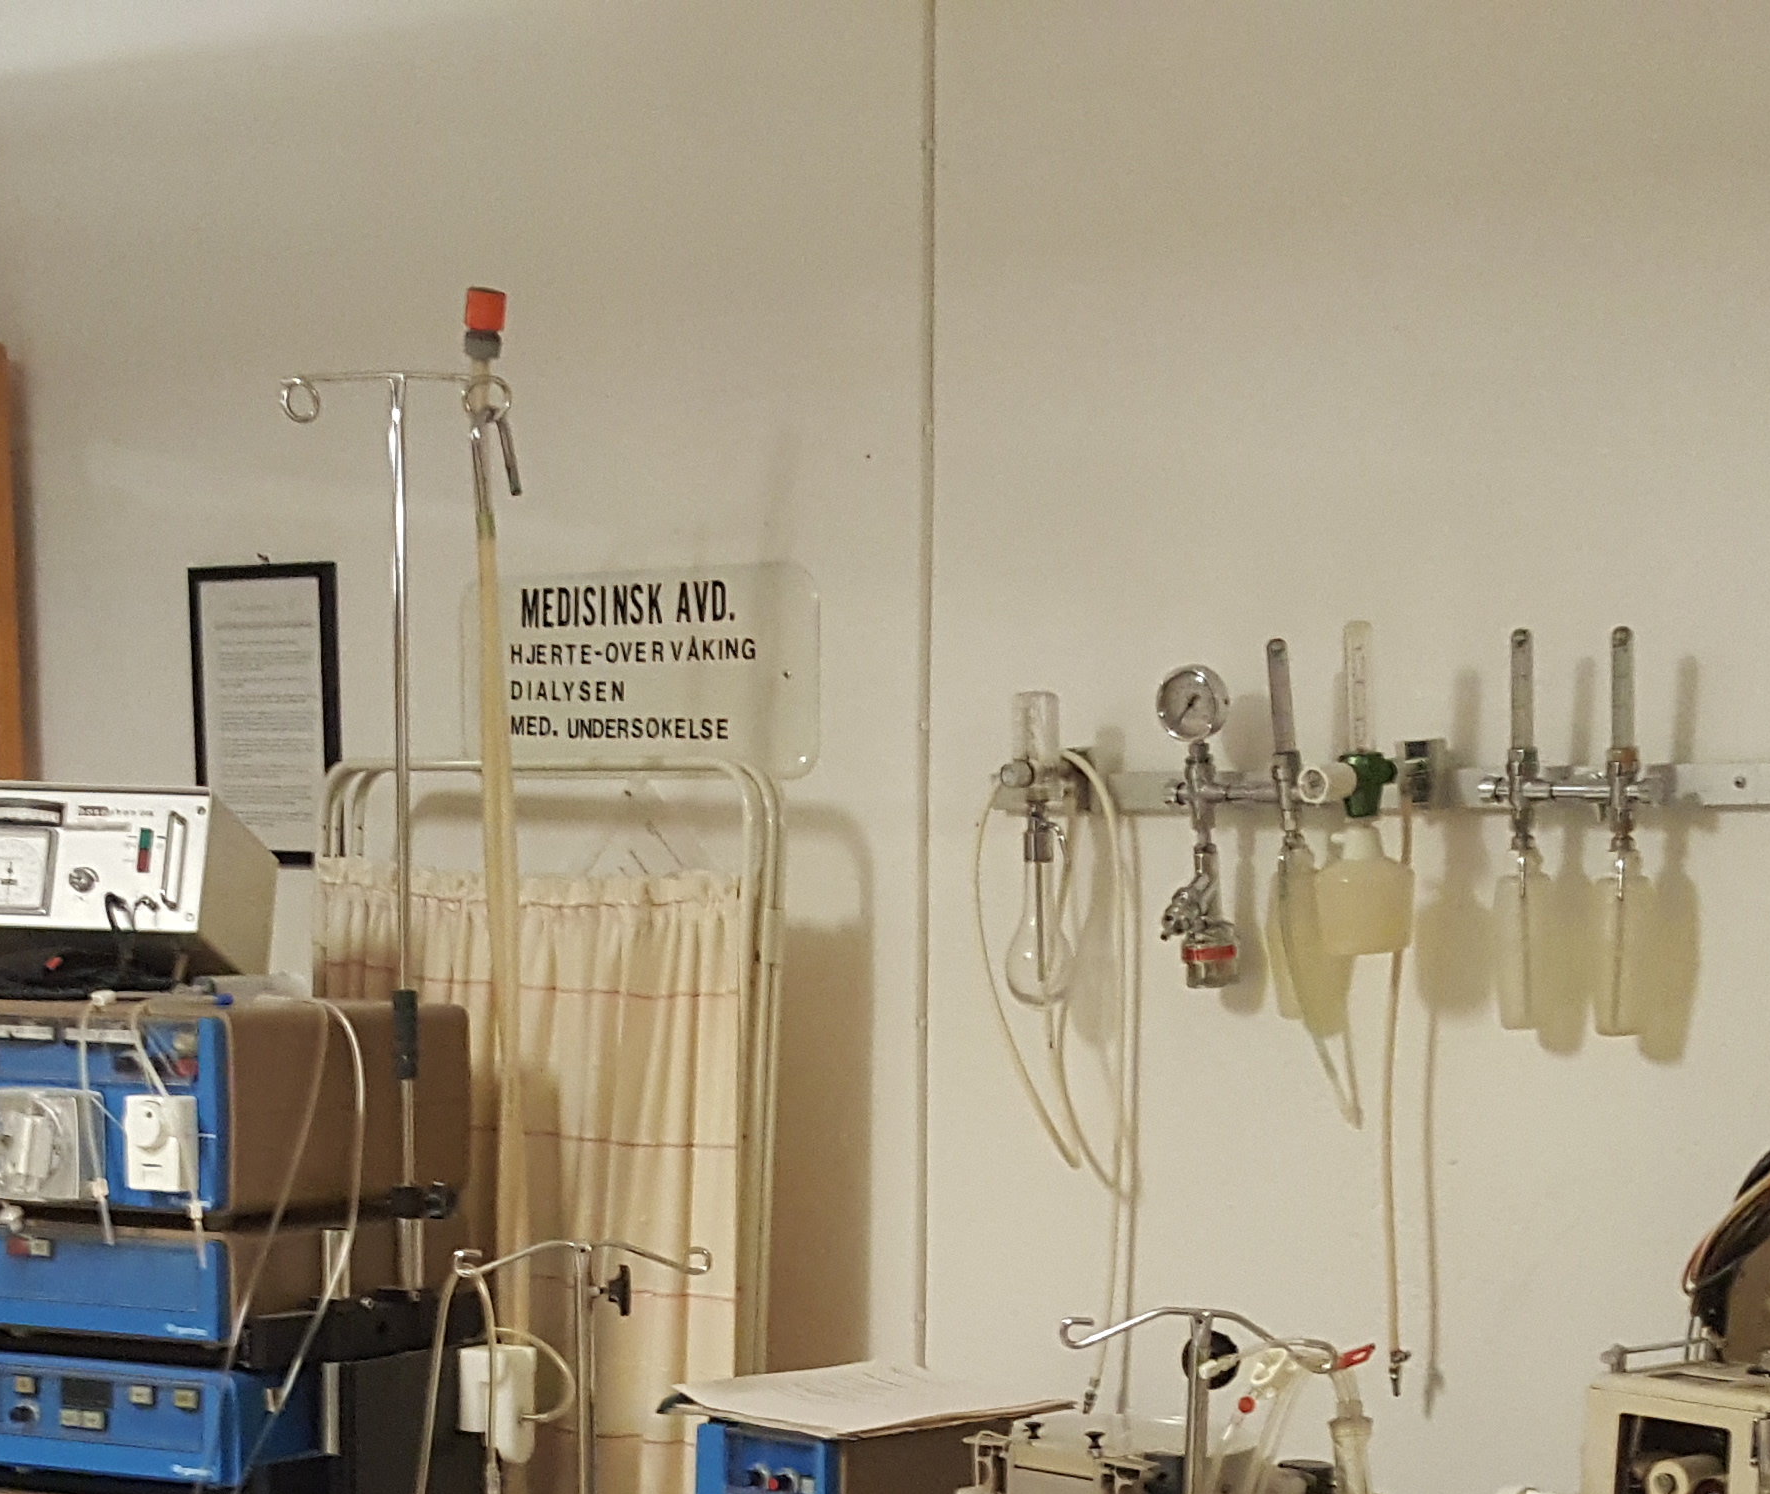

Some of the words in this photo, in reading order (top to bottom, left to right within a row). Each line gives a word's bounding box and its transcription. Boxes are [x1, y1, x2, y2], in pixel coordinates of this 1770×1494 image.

[521, 583, 663, 629] MEDISINSK
[676, 580, 735, 623] AVD.
[510, 680, 625, 701] DIALYSEN
[510, 715, 558, 737] MED.
